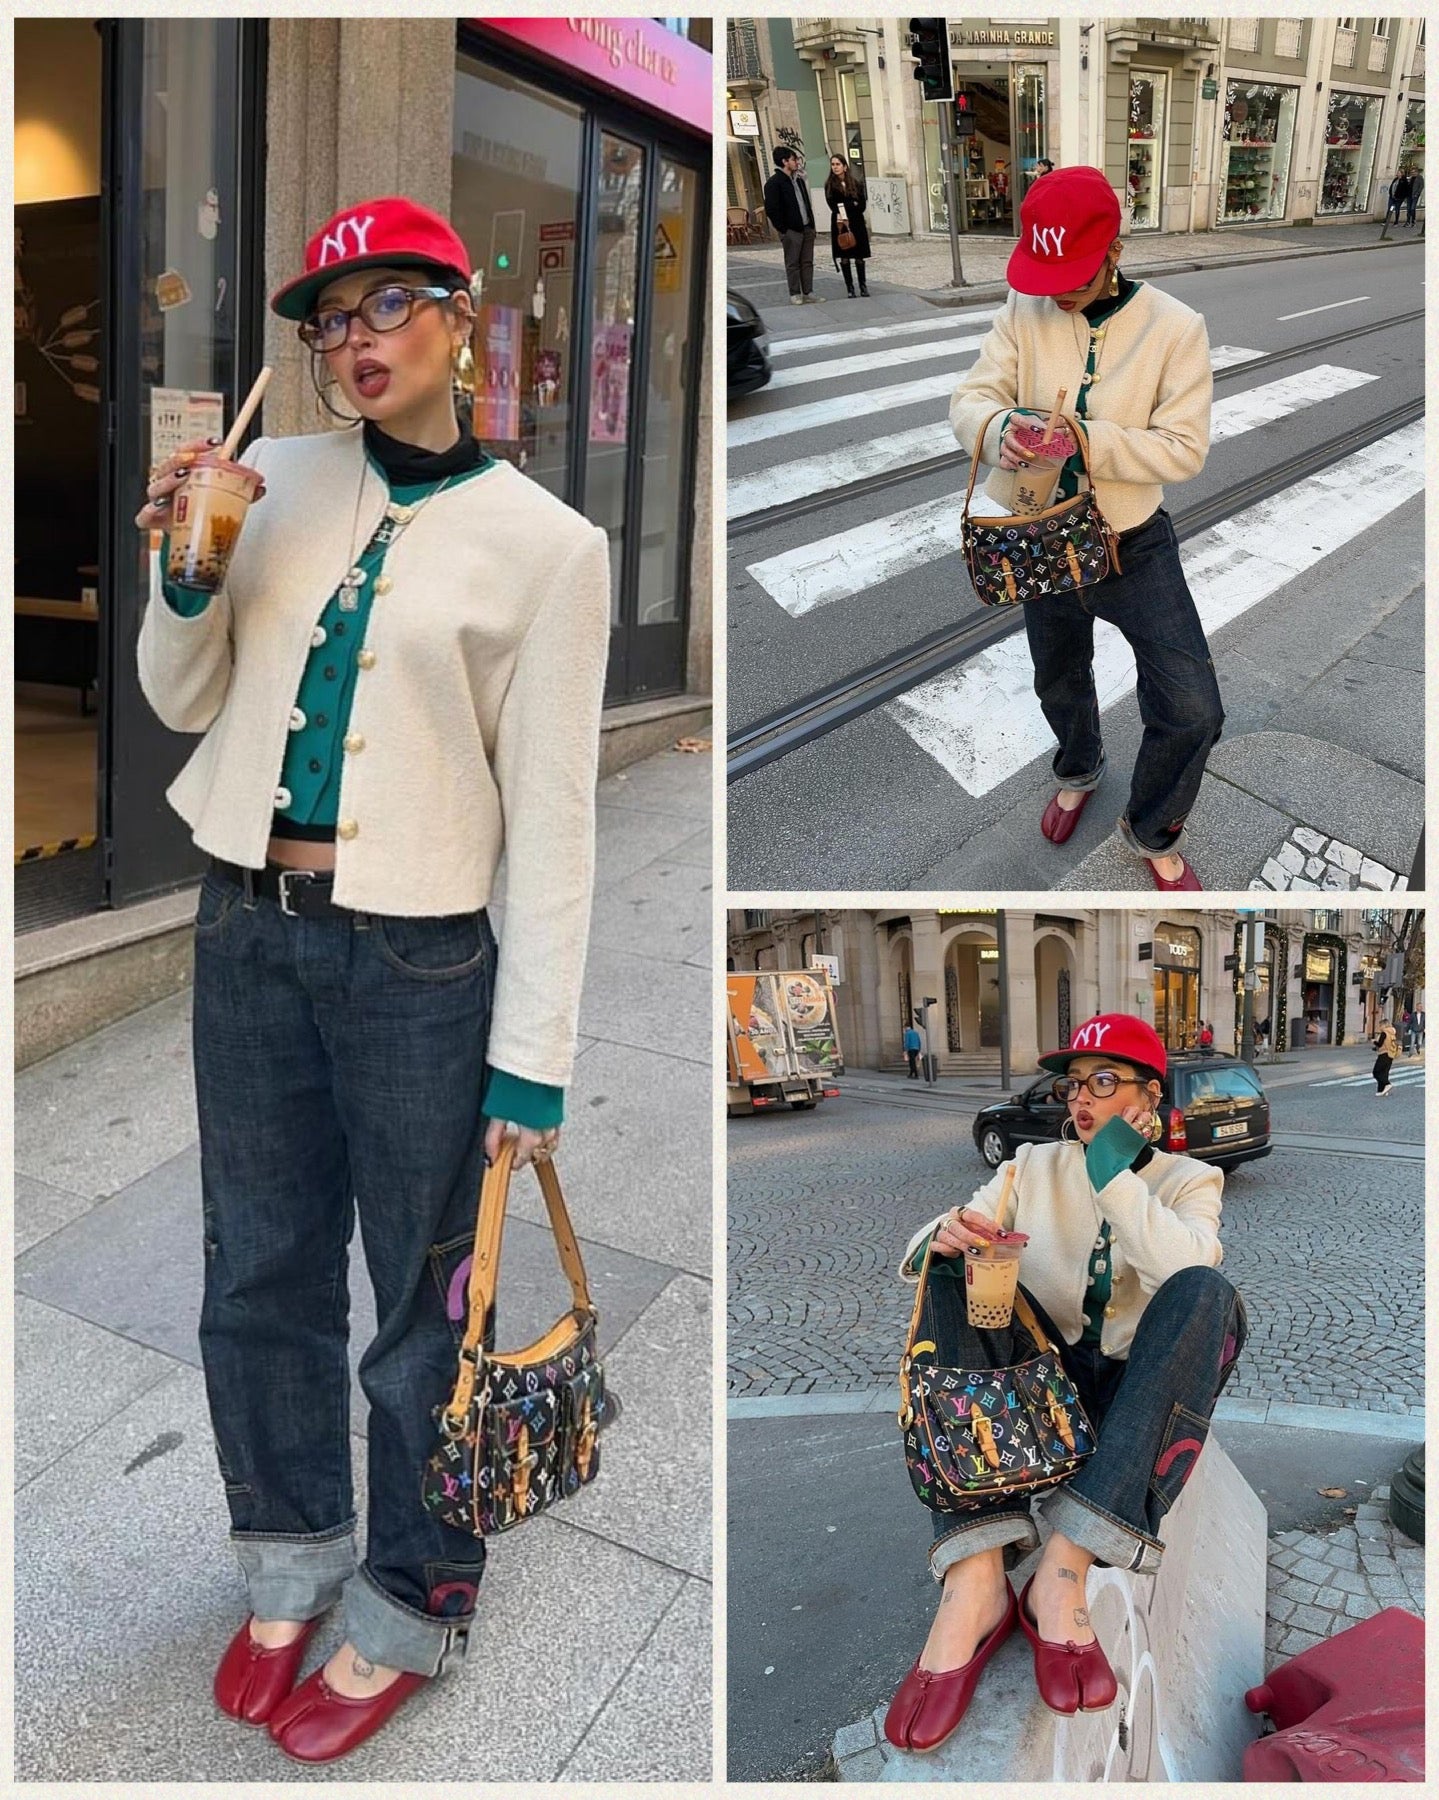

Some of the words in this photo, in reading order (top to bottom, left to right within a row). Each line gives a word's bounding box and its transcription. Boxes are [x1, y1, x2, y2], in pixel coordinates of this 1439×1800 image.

[950, 31, 961, 45] DA
[965, 30, 1010, 45] MARINHA
[1014, 30, 1054, 46] GRANDE
[319, 215, 375, 267] NY
[1032, 223, 1066, 257] NY
[1072, 1022, 1111, 1049] NY
[1022, 1445, 1041, 1467] LV
